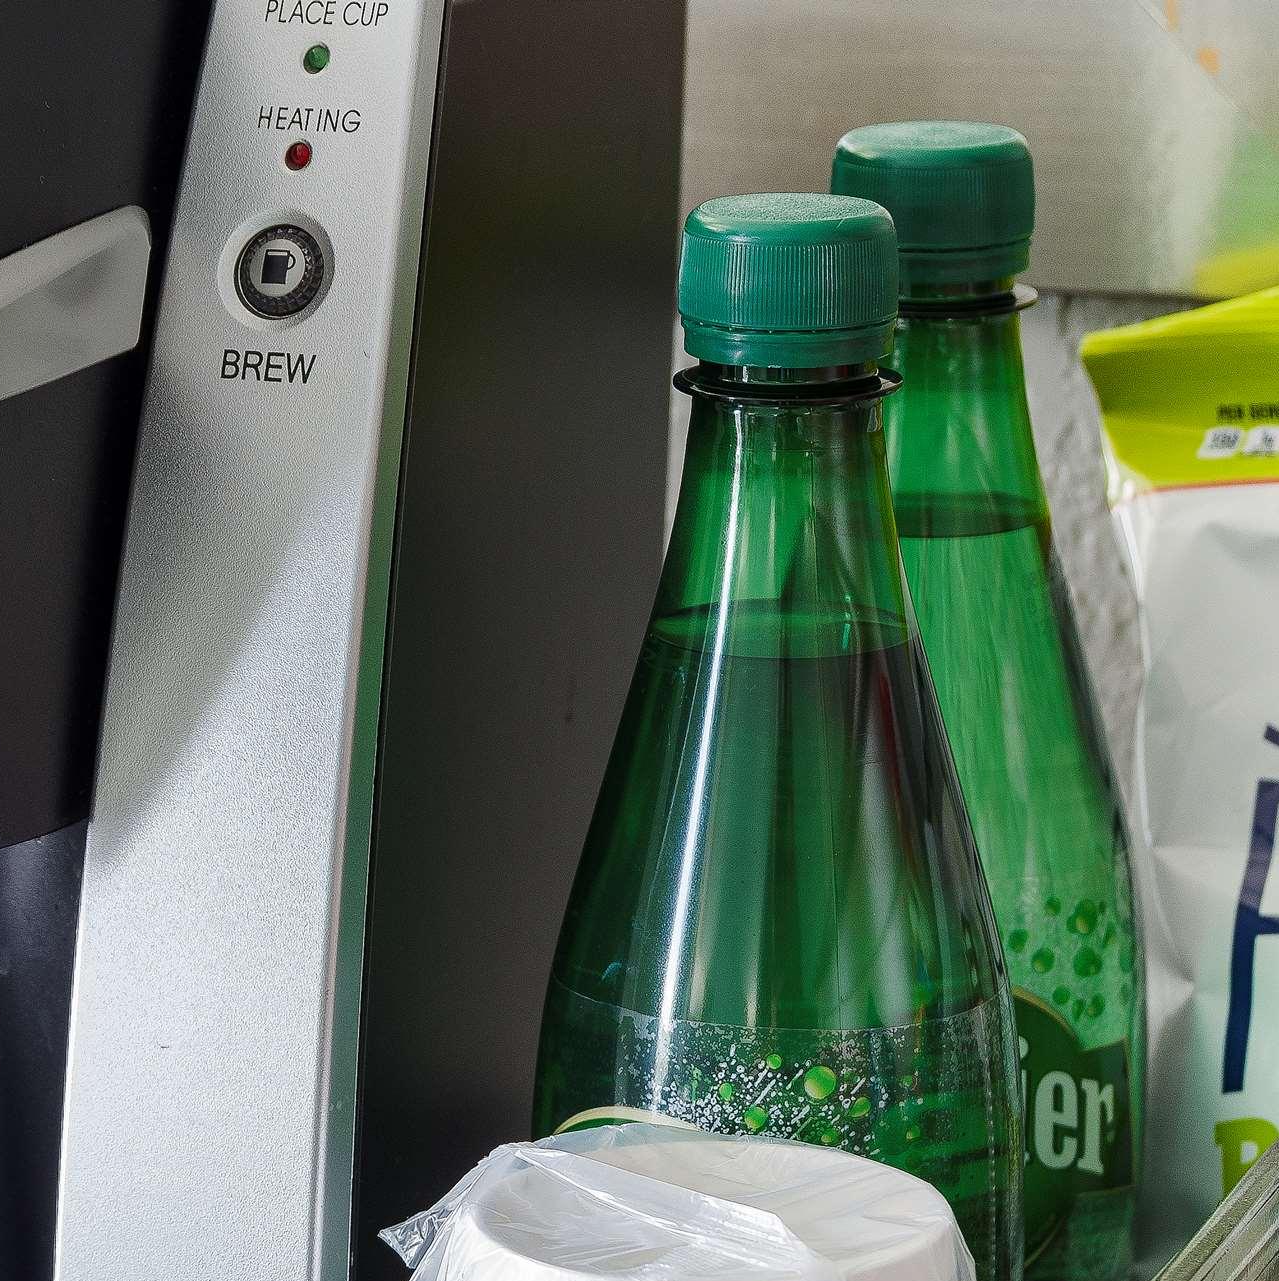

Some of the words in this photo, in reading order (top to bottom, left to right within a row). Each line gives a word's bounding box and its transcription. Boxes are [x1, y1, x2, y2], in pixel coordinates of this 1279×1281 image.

[264, 0, 336, 26] PLACE
[342, 1, 389, 28] CUP
[257, 105, 362, 134] HEATING
[220, 349, 317, 384] BREW
